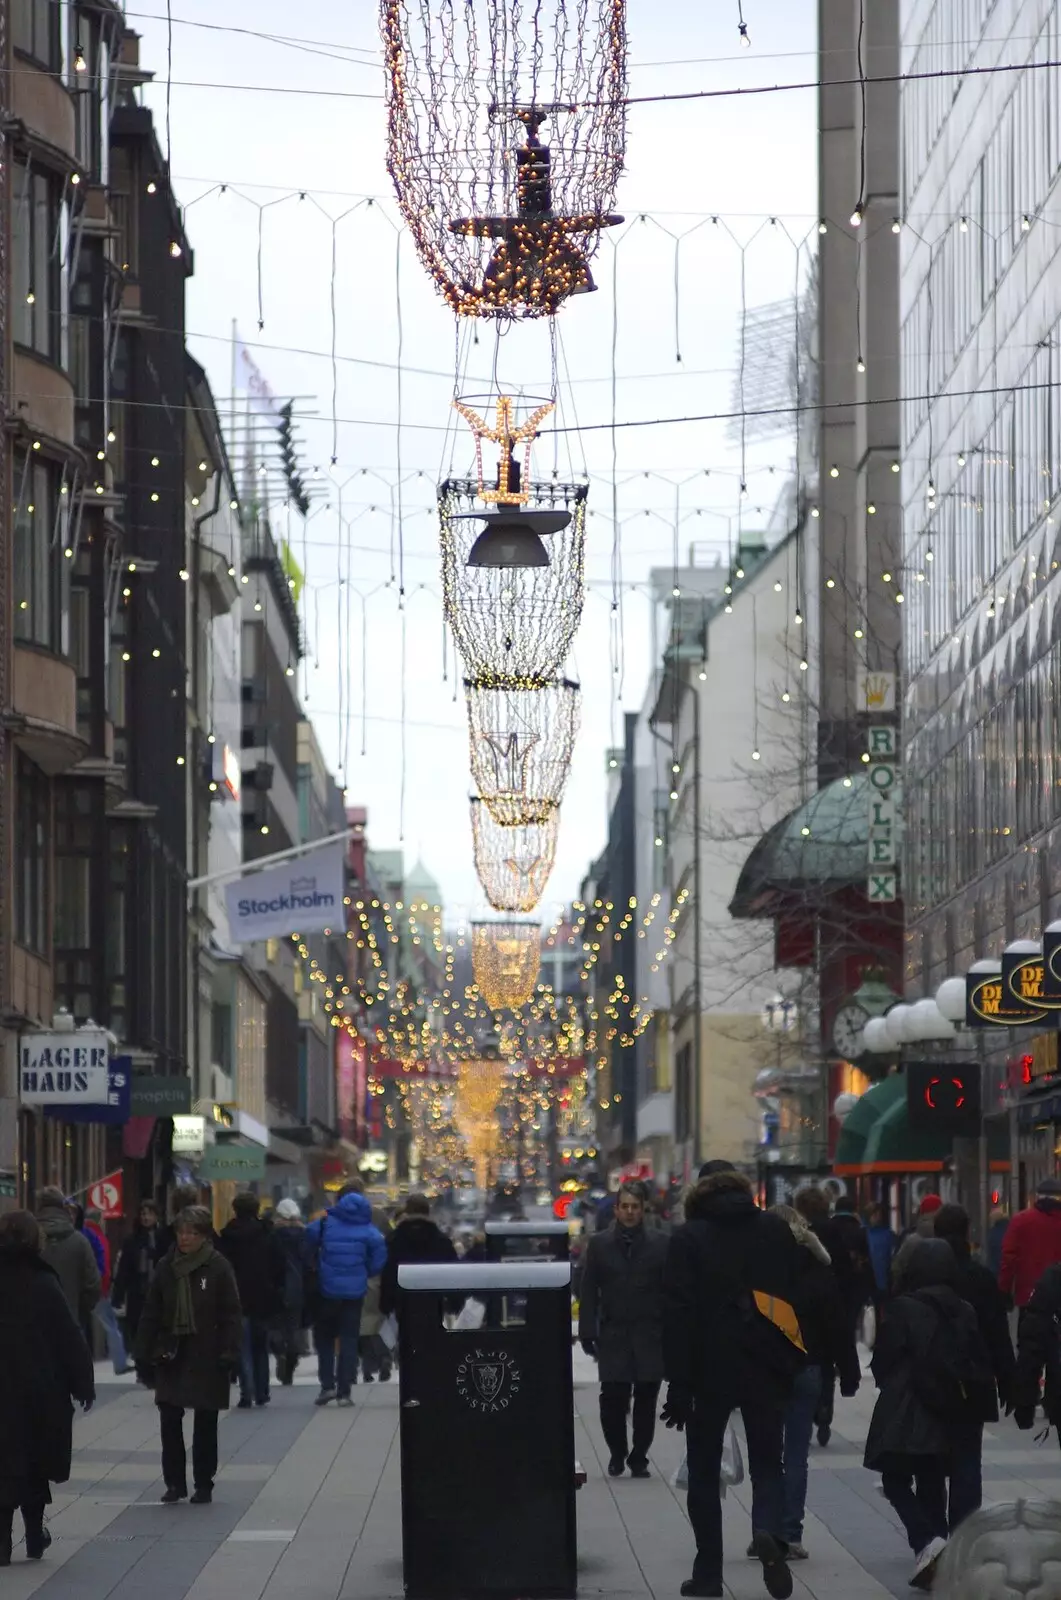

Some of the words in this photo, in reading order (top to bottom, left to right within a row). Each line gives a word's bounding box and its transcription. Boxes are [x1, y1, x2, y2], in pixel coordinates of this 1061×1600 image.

[871, 729, 894, 898] ROLEX
[238, 891, 335, 917] Stockholm
[22, 1047, 106, 1068] LAGER
[22, 1071, 89, 1092] HAUS
[469, 1398, 510, 1413] STAD
